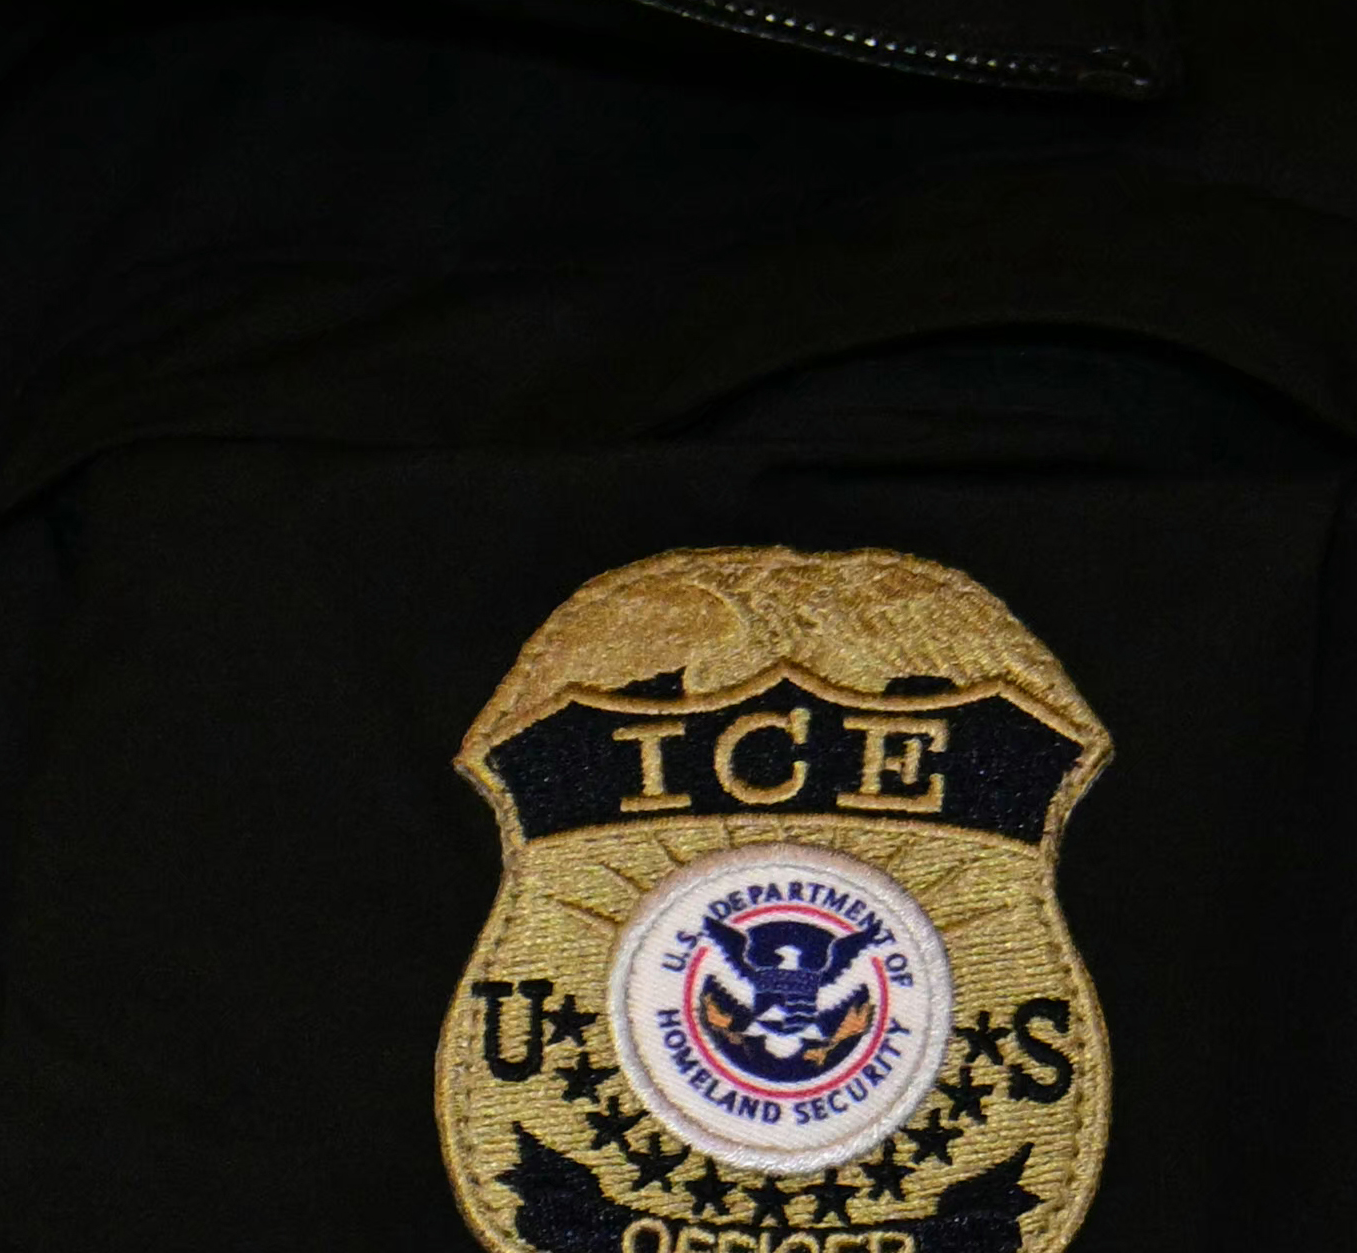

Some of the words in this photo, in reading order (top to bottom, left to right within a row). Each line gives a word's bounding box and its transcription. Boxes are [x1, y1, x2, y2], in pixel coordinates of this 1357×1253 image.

[612, 707, 951, 813] ICE
[709, 881, 897, 947] DEPARTMENT
[886, 952, 914, 990] OF
[471, 980, 553, 1083] U
[1008, 998, 1071, 1104] S
[658, 1008, 781, 1124] HOMELAND
[794, 1017, 912, 1125] SECURITY
